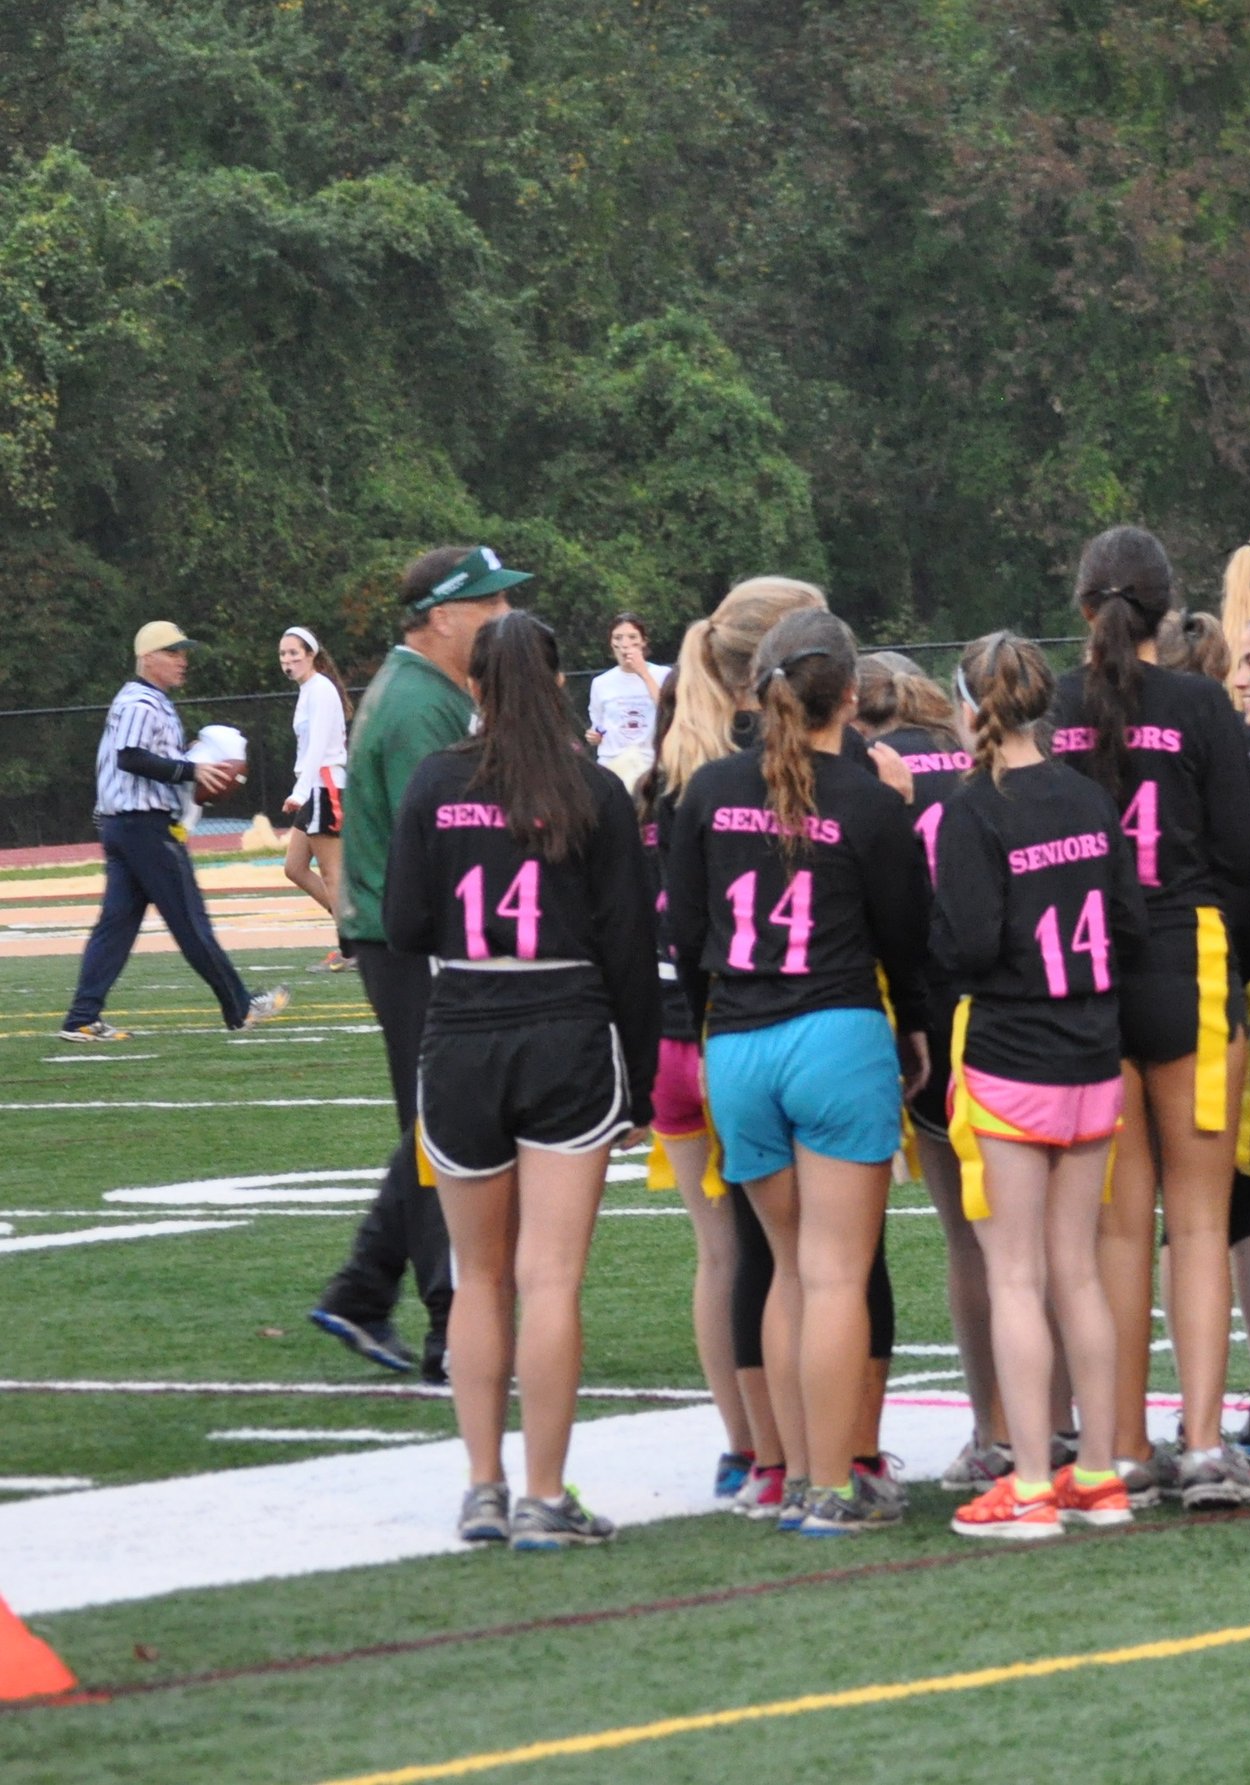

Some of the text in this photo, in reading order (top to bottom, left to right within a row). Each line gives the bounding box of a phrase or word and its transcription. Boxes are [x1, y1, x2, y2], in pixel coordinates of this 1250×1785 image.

[901, 751, 974, 775] ENIO
[1052, 724, 1182, 754] SEORS
[712, 806, 842, 845] SENRS
[914, 802, 945, 890] 1
[1008, 831, 1110, 875] SENIORS
[1120, 779, 1162, 887] 4
[455, 859, 543, 961] 14
[725, 869, 815, 975] 14
[1034, 888, 1113, 998] 14
